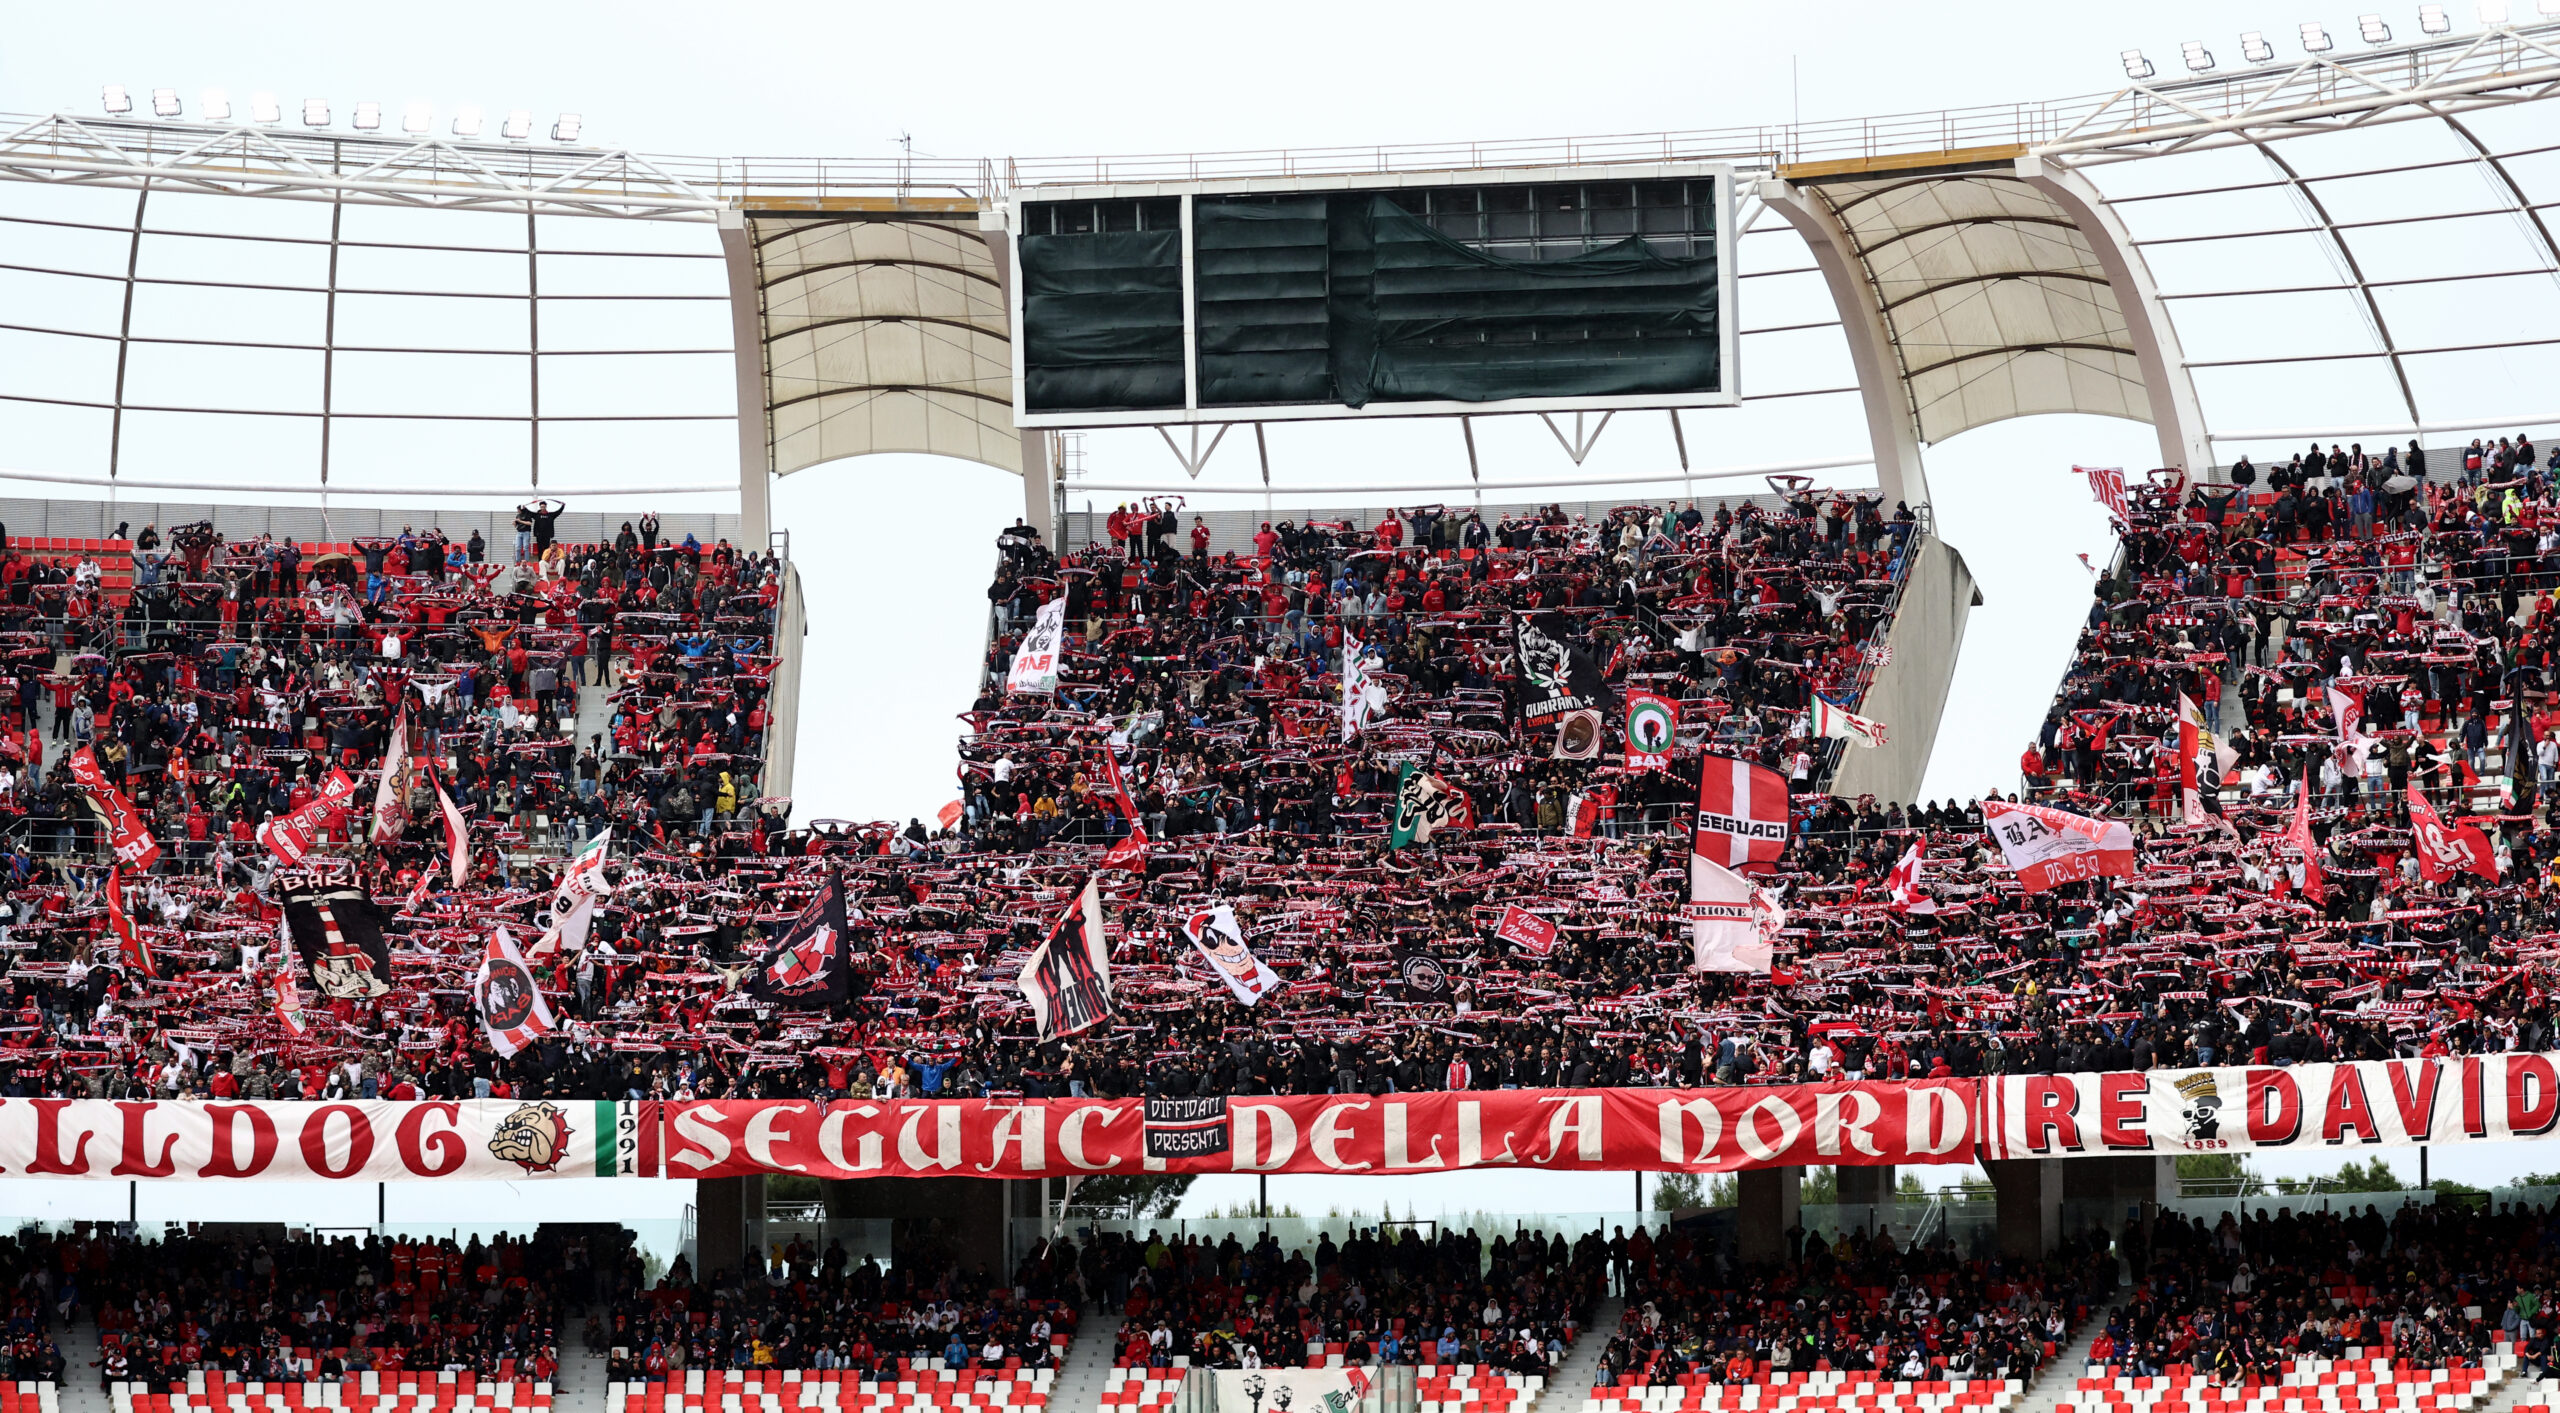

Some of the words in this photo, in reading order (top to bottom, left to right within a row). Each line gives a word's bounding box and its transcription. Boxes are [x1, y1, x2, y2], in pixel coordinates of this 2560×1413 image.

[1525, 698, 1583, 718] QUARANTA
[1527, 714, 1556, 728] CURVA
[1700, 814, 1784, 839] SEGUACI
[2356, 839, 2385, 847] CURVA
[280, 874, 365, 891] BARI
[1695, 905, 1747, 918] RIONE
[1251, 918, 1290, 934] BARI
[1517, 912, 1545, 935] Vita
[1504, 923, 1546, 950] Nostra
[1151, 1097, 1220, 1118] DIFFIDATI
[2025, 1072, 2153, 1153] RE
[2246, 1054, 2560, 1146] DAVID
[0, 1099, 467, 1180] LLDOG
[618, 1100, 635, 1174] 1991
[1153, 1128, 1220, 1151] PRESENTI
[1231, 1095, 1603, 1172] DELLA
[1659, 1085, 1969, 1164] NORD
[2183, 1139, 2228, 1150] 1989
